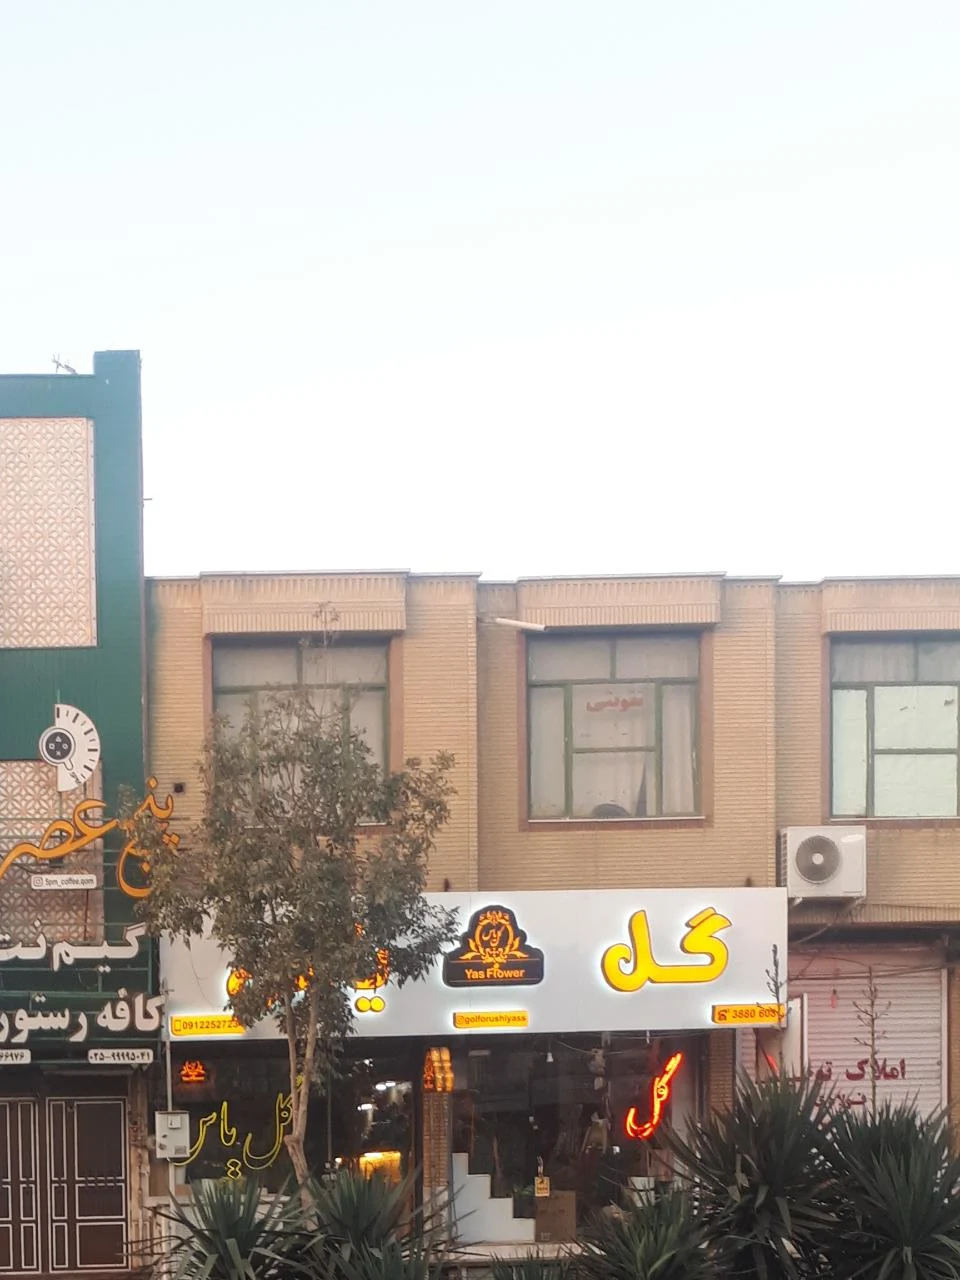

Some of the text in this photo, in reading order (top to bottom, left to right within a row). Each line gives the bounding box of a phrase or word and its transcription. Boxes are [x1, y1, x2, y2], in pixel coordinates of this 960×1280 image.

[52, 921, 147, 973] گیم
[465, 967, 526, 979] Yas Flower
[601, 907, 732, 992] گل
[96, 987, 166, 1032] کافه
[623, 1051, 683, 1140] گل
[168, 1101, 242, 1179] یاس
